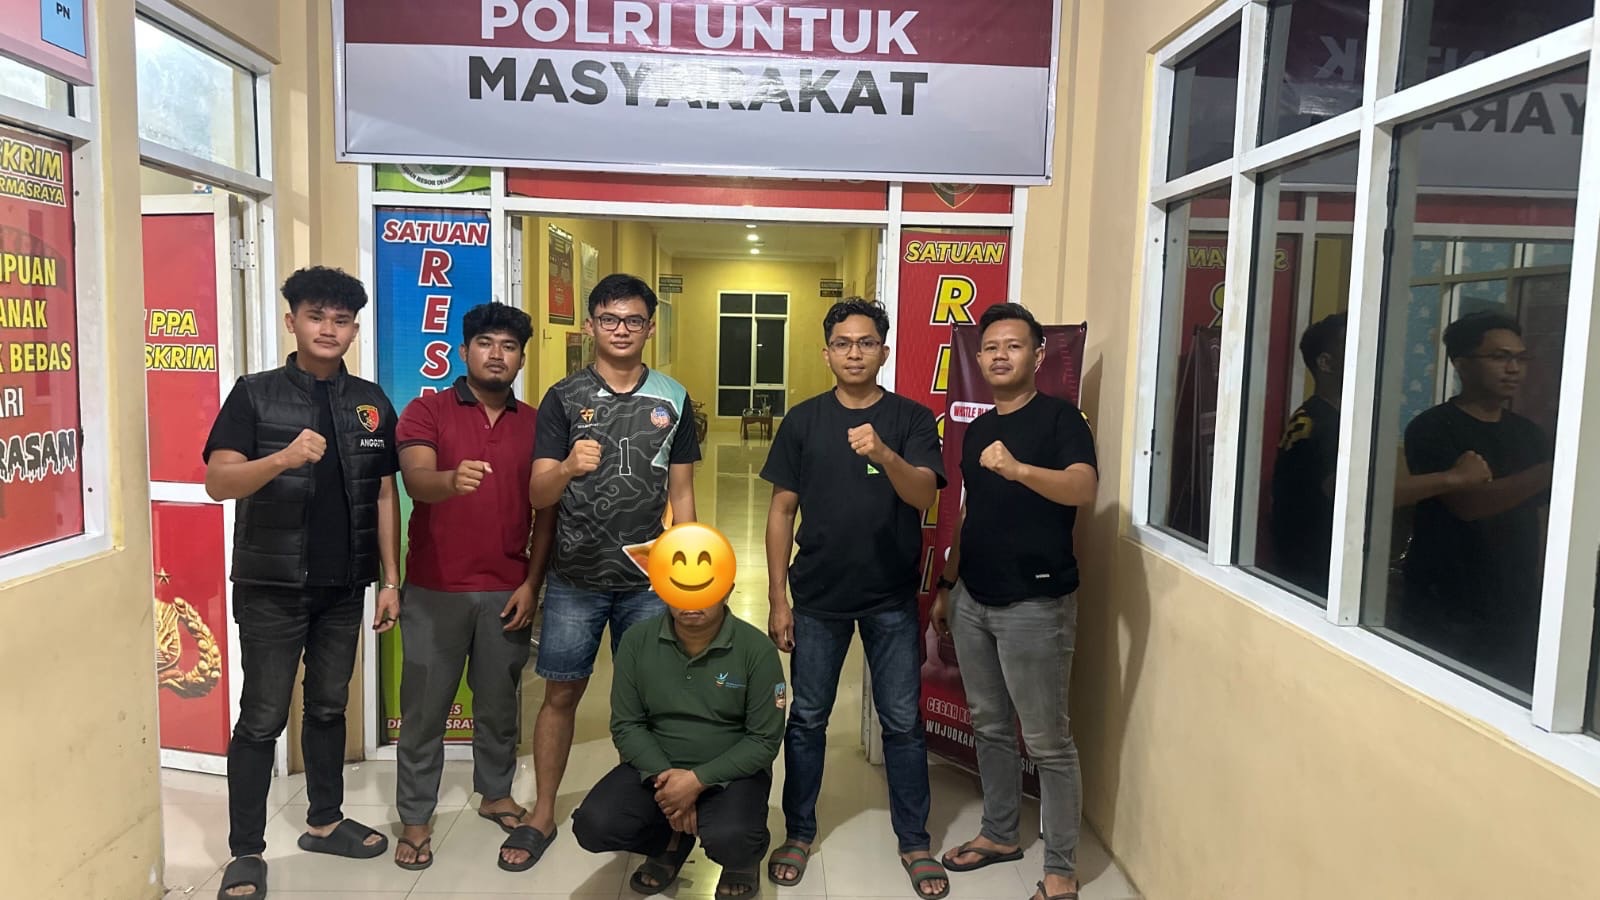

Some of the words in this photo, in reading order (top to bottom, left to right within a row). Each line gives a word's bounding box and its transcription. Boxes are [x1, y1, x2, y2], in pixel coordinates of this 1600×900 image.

[56, 3, 71, 20] PN
[481, 0, 672, 46] POLRI
[695, 4, 919, 56] UNTUK
[0, 137, 63, 184] KRIM
[381, 219, 490, 247] SATUAN
[904, 240, 1007, 265] SATUAN
[149, 309, 199, 337] PPA
[9, 342, 73, 373] BEBAS
[618, 437, 632, 476] 1
[927, 697, 959, 720] CEGAH
[925, 720, 976, 749] WUJUDKAN
